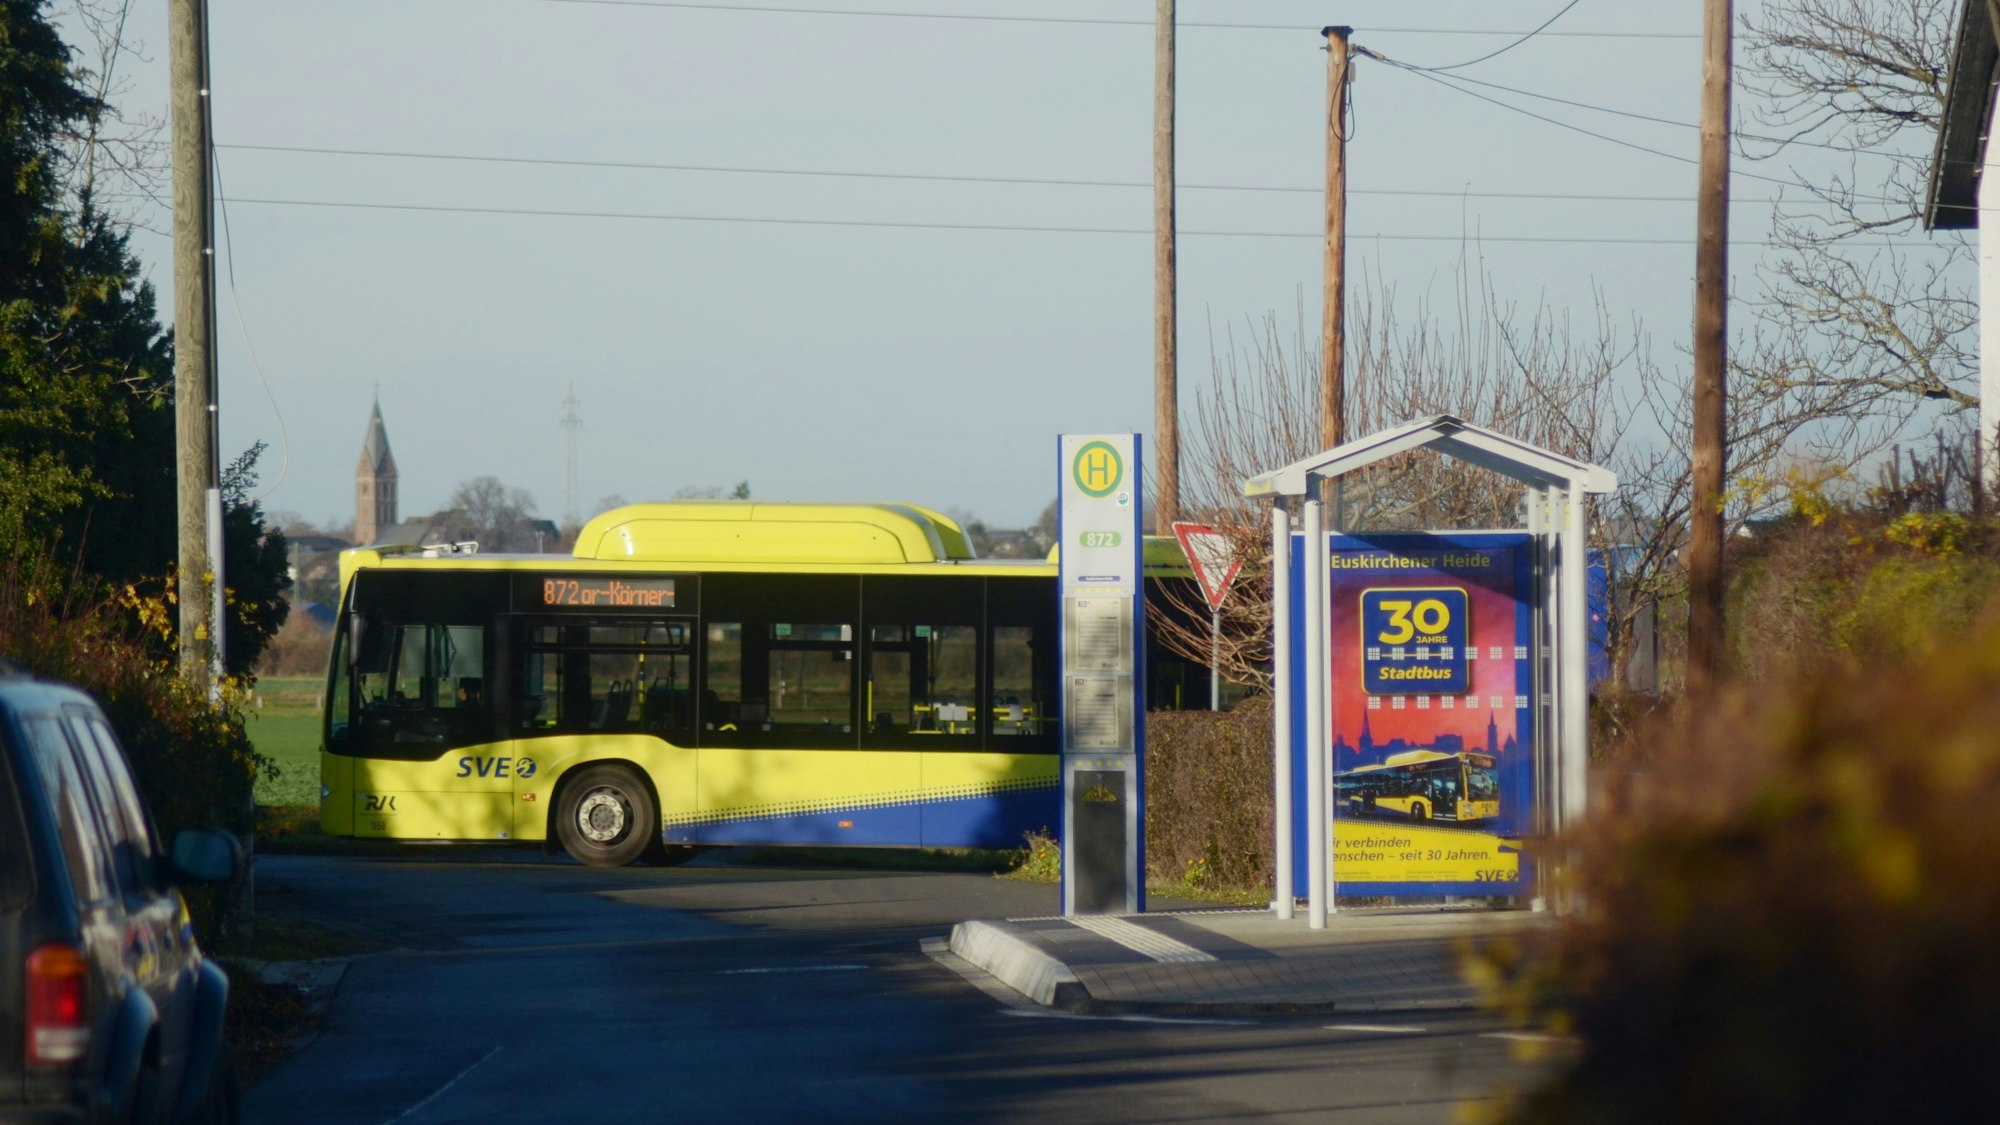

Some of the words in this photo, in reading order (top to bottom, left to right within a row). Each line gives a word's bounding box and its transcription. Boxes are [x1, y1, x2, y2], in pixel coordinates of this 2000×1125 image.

[1087, 453, 1108, 486] H
[1086, 532, 1114, 547] 872
[1331, 554, 1437, 569] Euskirchener
[1443, 554, 1491, 568] Heide
[544, 579, 579, 605] 872
[1378, 599, 1450, 645] 30
[1416, 635, 1448, 644] JAHRE
[1379, 665, 1452, 680] Stadtbus
[456, 756, 512, 778] SVE
[1345, 836, 1411, 848] verbinden
[1333, 850, 1384, 861] enschen
[1400, 850, 1422, 861] seit
[1426, 850, 1442, 861] 30
[1445, 850, 1492, 861] Jahren.
[1475, 869, 1505, 882] SVE
